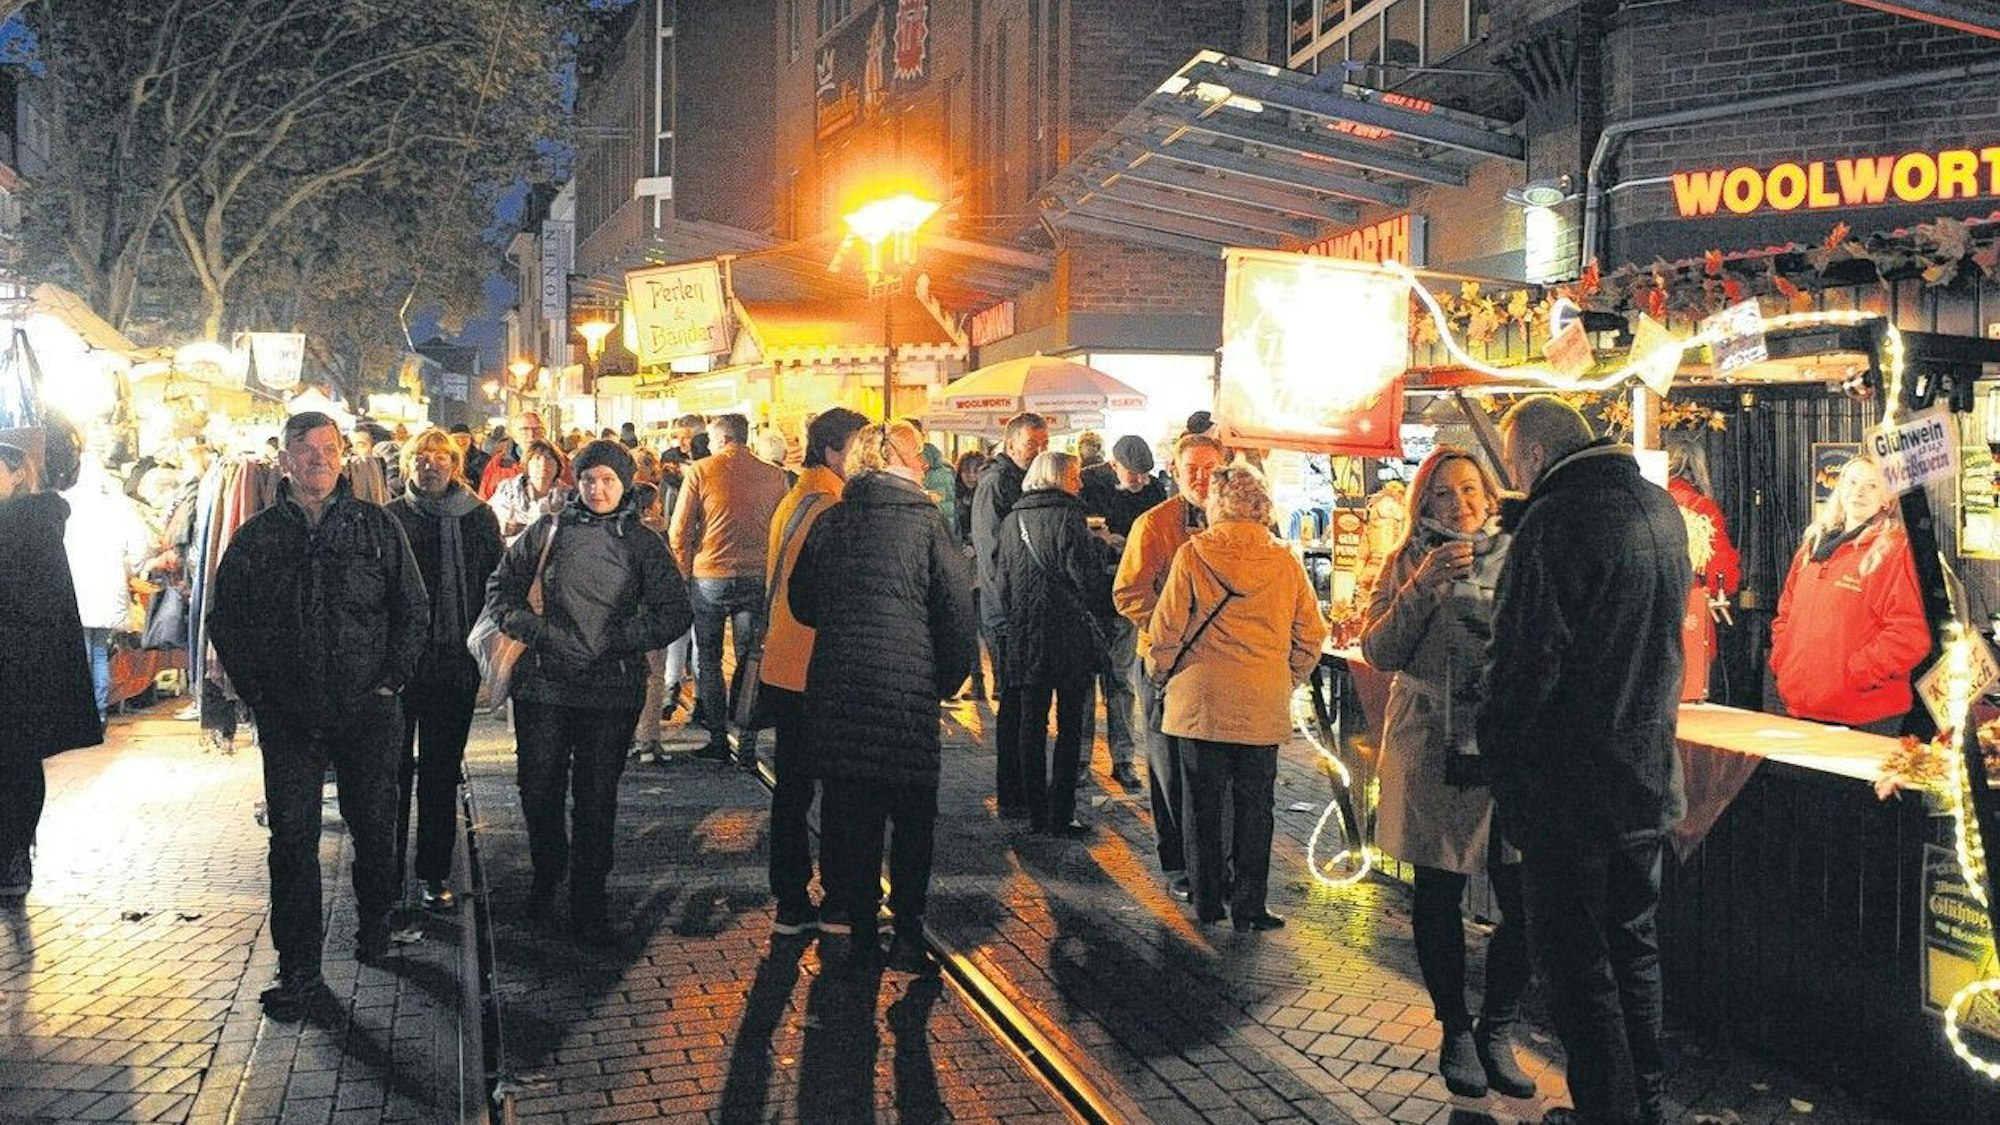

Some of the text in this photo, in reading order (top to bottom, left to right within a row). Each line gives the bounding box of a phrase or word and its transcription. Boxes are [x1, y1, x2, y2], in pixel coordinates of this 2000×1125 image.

[645, 277, 705, 310] Perlen
[955, 399, 1012, 410] WOOLWORTH
[1875, 420, 1945, 457] Glühwein
[1883, 452, 1950, 486] Weißwein
